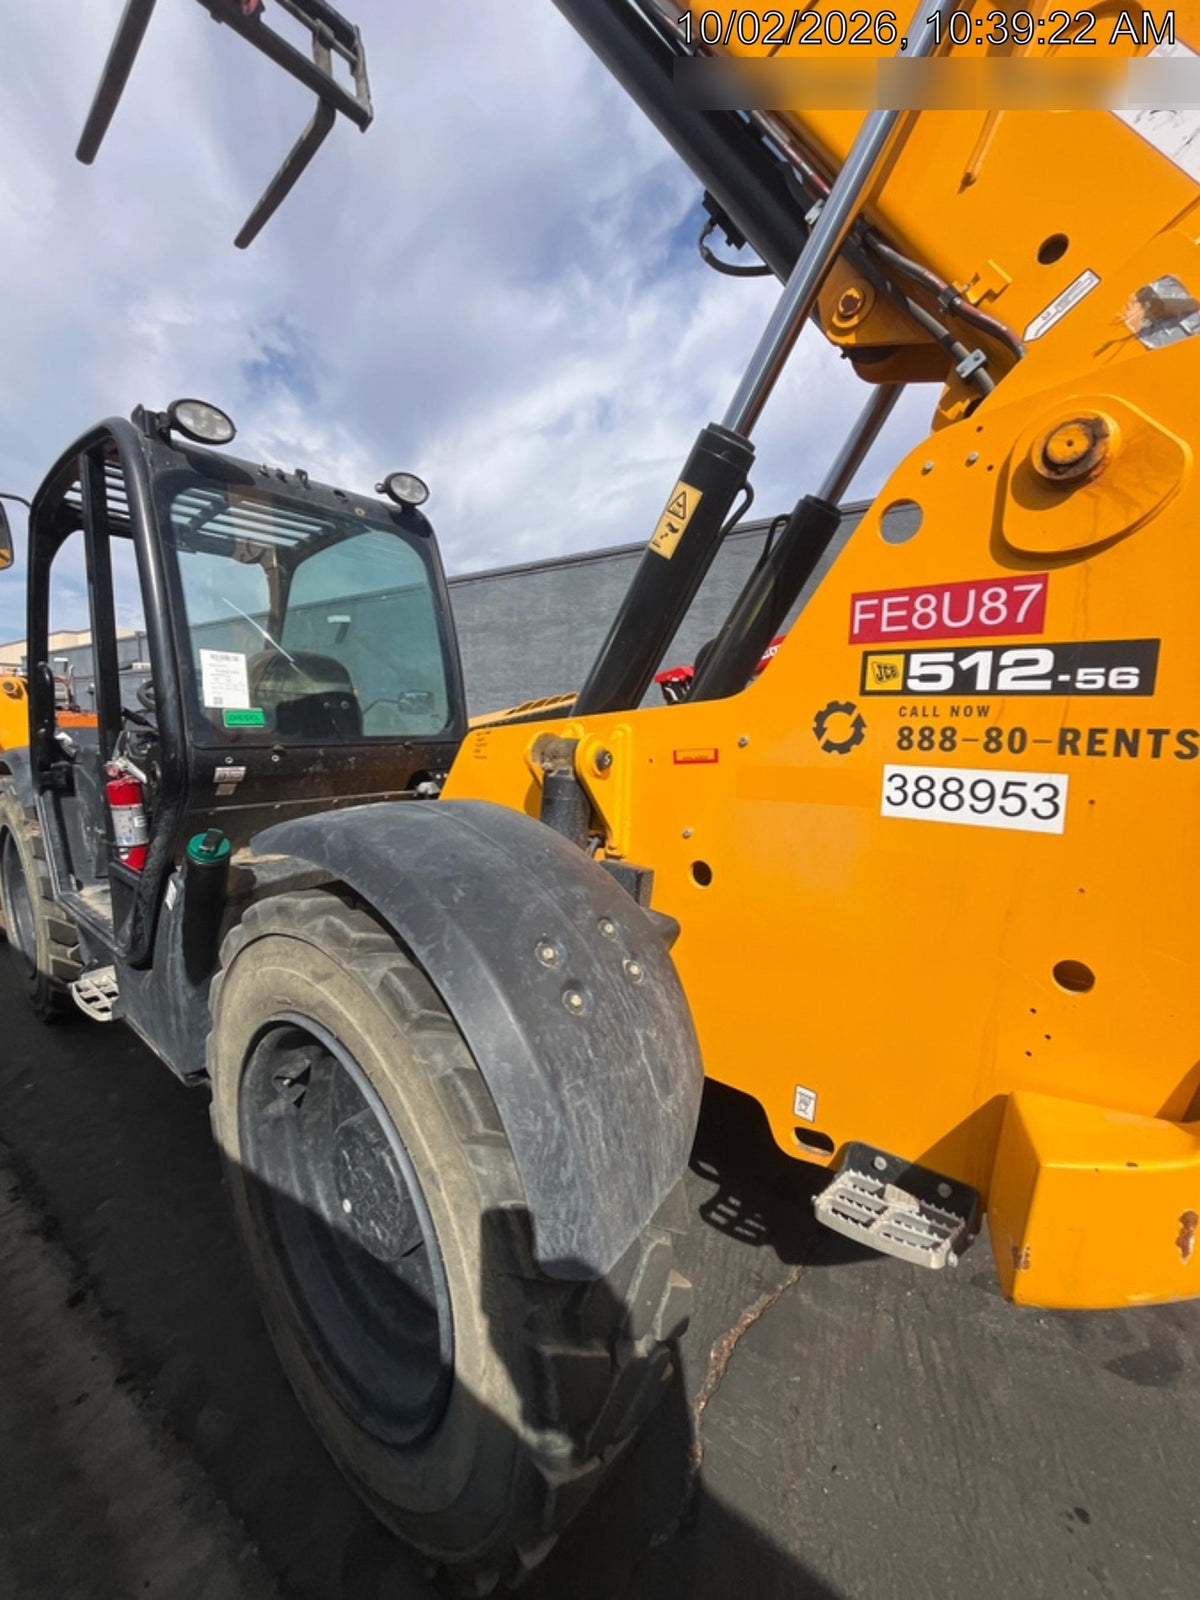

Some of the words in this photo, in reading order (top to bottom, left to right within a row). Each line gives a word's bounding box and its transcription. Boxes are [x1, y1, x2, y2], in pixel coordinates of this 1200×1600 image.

[852, 583, 1043, 635] FE8U87
[906, 648, 1141, 692] 512-56
[898, 705, 941, 718] CALL
[950, 705, 991, 718] NOW
[885, 773, 1061, 821] 388953
